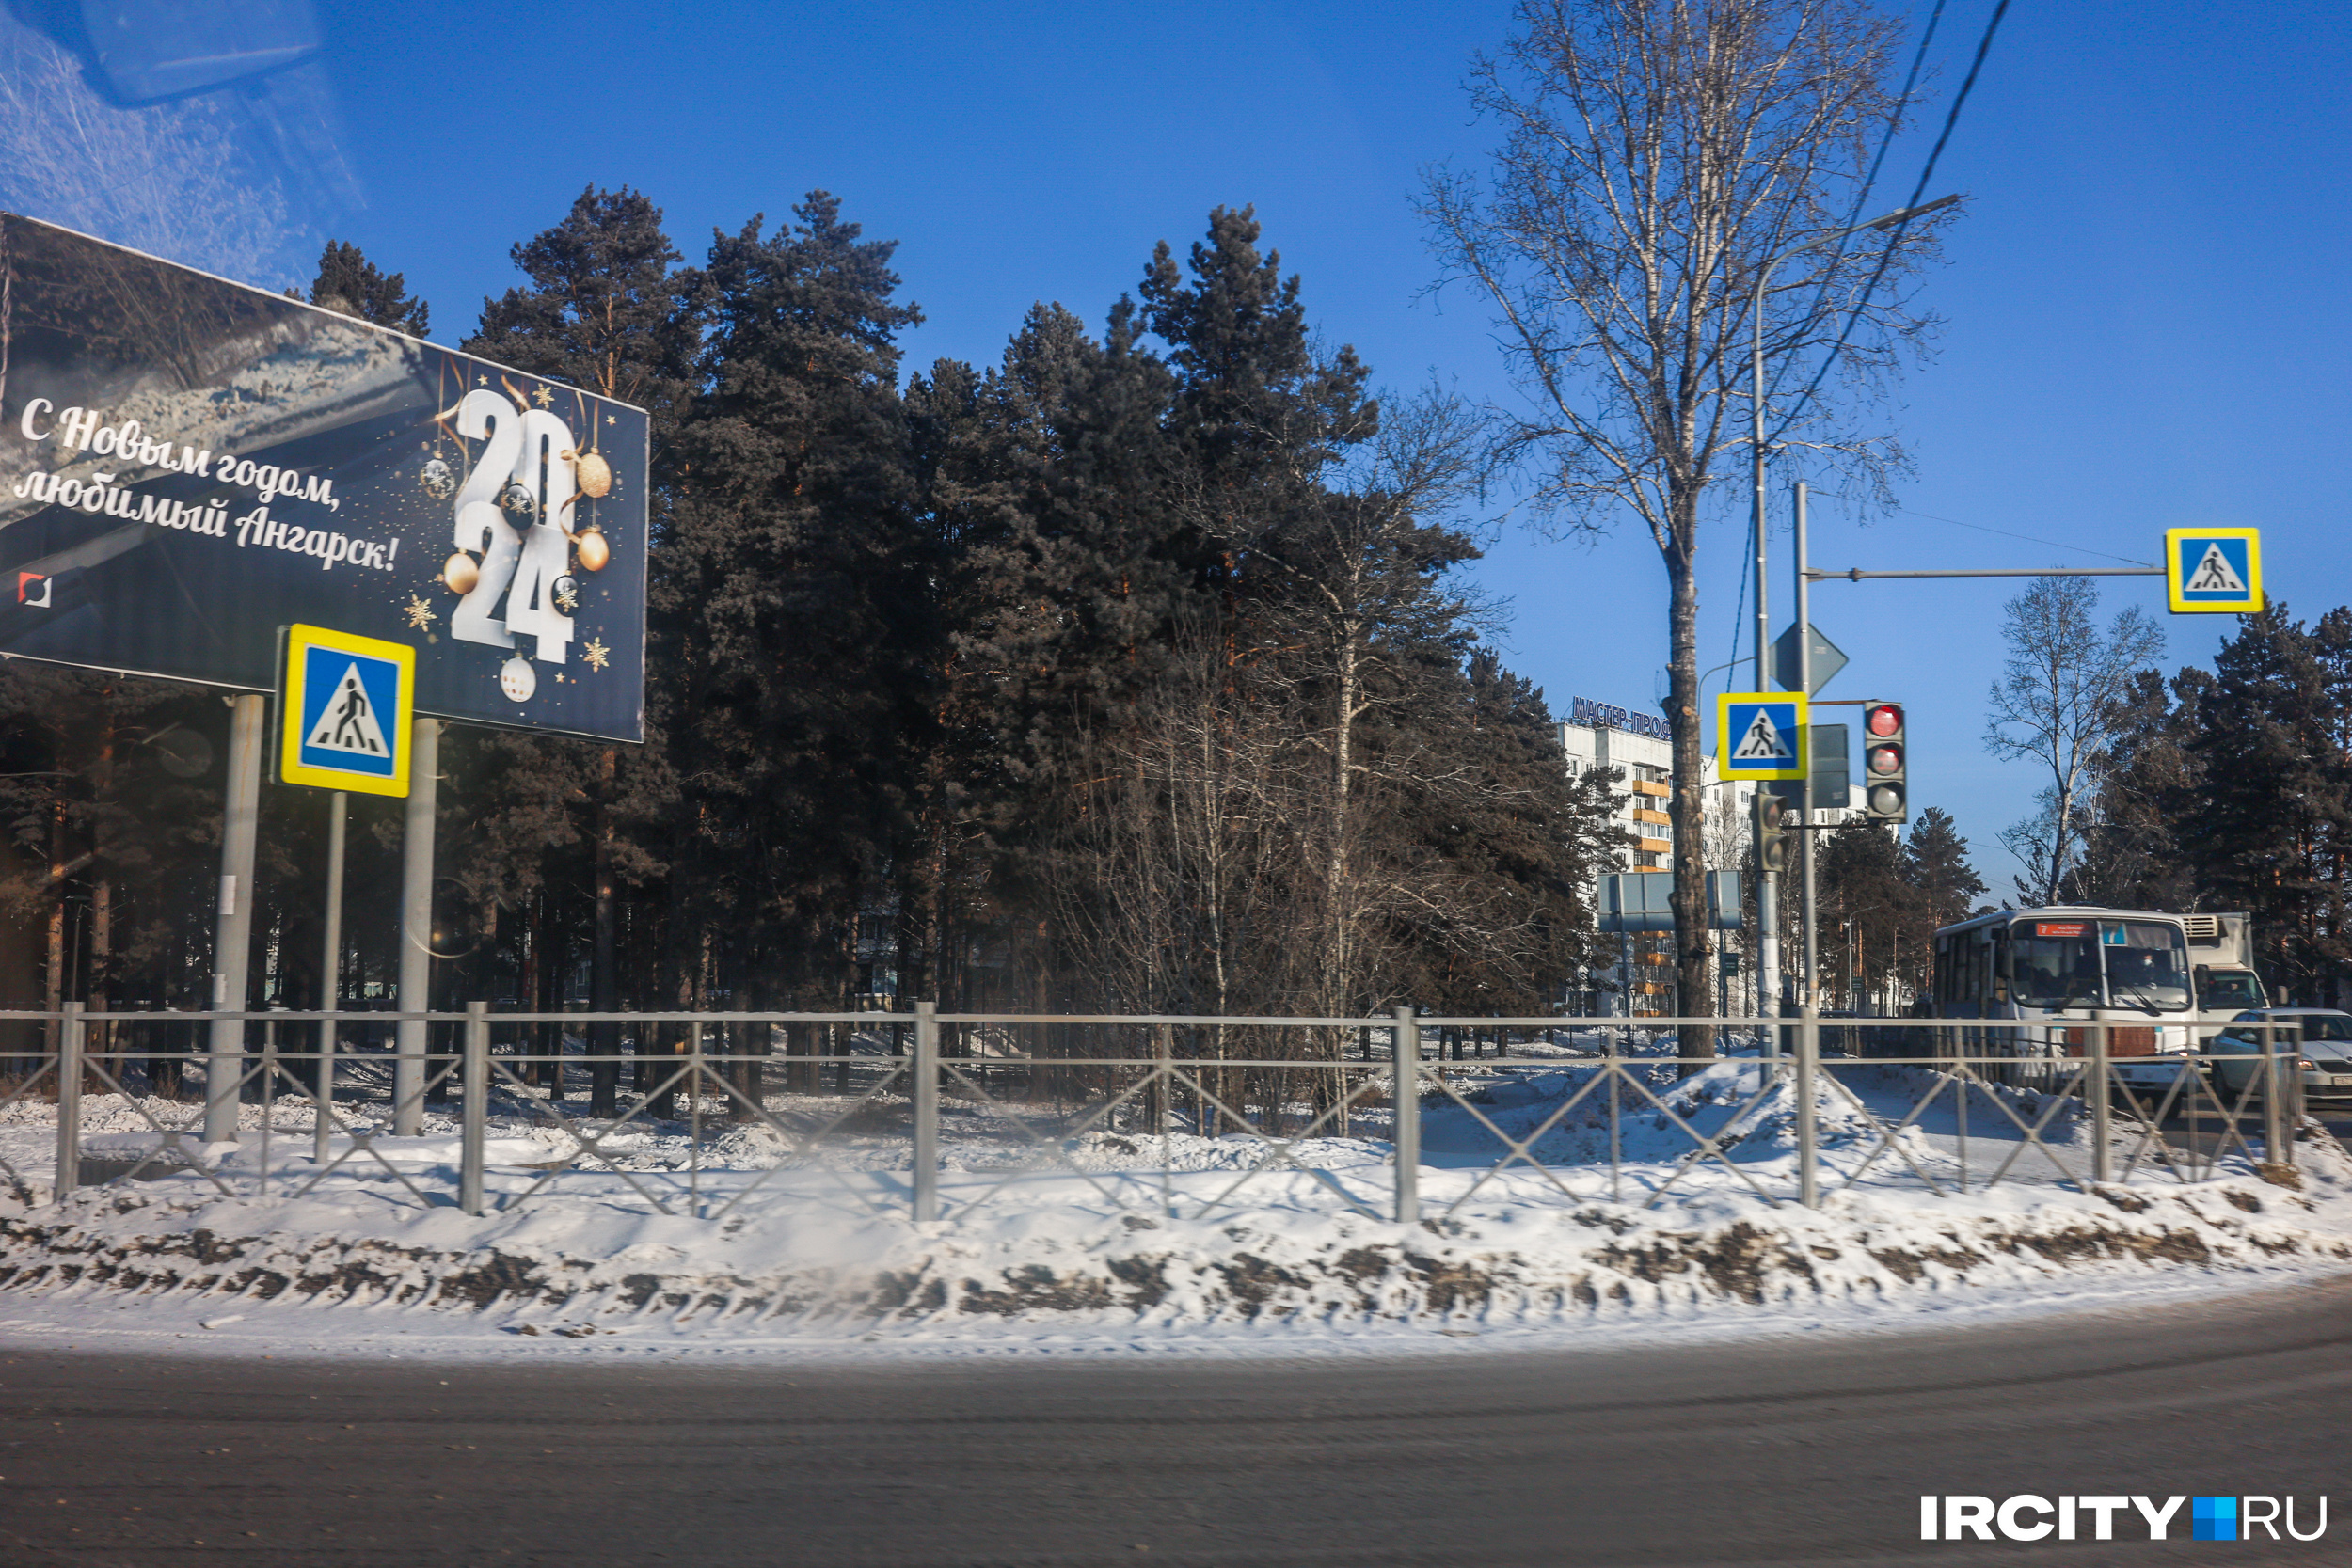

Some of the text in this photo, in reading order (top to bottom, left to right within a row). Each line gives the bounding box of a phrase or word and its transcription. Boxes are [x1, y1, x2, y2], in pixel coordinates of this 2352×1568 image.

[20, 397, 341, 513] С Новым годом,
[13, 470, 401, 573] любимый Ангарск!
